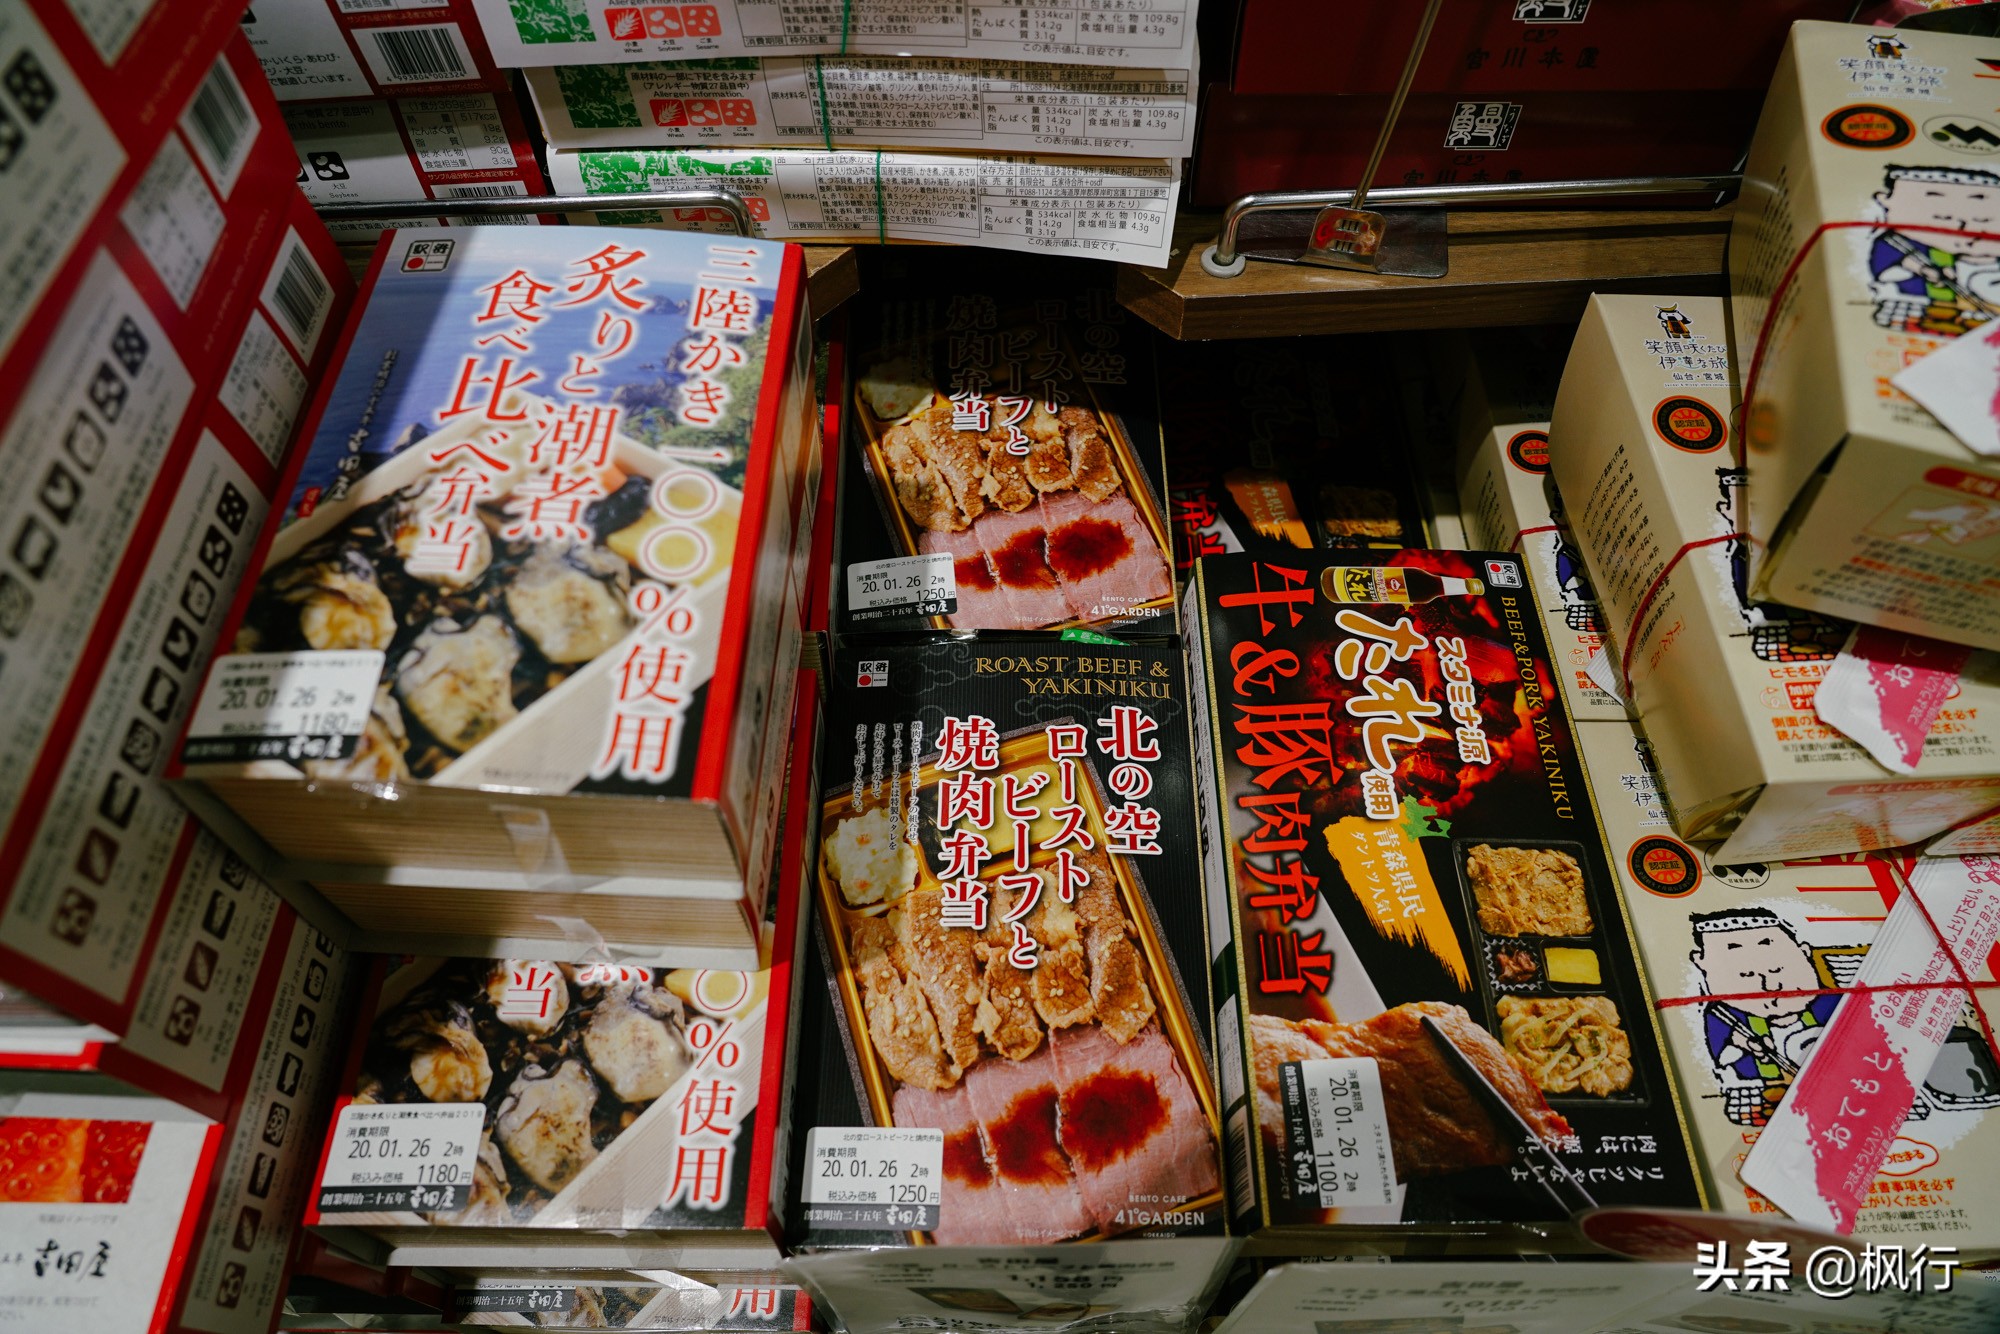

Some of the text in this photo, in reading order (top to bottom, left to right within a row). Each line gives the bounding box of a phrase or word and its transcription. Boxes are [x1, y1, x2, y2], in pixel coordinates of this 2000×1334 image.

[1034, 9, 1073, 20] 534kcal
[1145, 14, 1179, 25] 109.8g
[1034, 19, 1062, 31] 14.2g
[1081, 22, 1165, 36] 食塩相当量 4.3g
[1034, 30, 1055, 42] 3.1g
[771, 91, 807, 100] 原材料名
[461, 112, 497, 122] 517kcal
[1045, 106, 1081, 115] 534kcal
[1148, 110, 1179, 119] 109.8g
[1045, 116, 1071, 126] 14.2g
[1088, 118, 1166, 129] 食塩相当量 4.3g
[1045, 125, 1065, 135] 3.1g
[484, 135, 506, 145] 9.2g
[492, 157, 514, 167] 3.3g
[1019, 178, 1045, 186] 有限会社
[1038, 210, 1072, 219] 534kcal
[1133, 212, 1160, 224] 109.8g
[1038, 220, 1062, 228] 14.2g
[1078, 219, 1149, 233] 食塩相当量 4.3g
[1038, 228, 1057, 237] 3.1g
[947, 294, 999, 432] 焼肉弁当
[505, 244, 648, 541] 炙りと潮煮
[996, 330, 1038, 457] ビーフと
[411, 268, 556, 573] 食べ比べ弁当
[1674, 419, 1707, 428] 認定証
[856, 572, 888, 582] 消費期限
[906, 576, 921, 588] 26
[931, 576, 945, 585] 2時
[869, 597, 908, 606] 税込み価格
[916, 600, 948, 615] 吉田屋
[975, 656, 1171, 678] ROAST BEEF &
[1022, 677, 1172, 700] YAKINIKU
[1435, 636, 1492, 766] スタミナ源
[1335, 609, 1442, 821] たれ 使用
[1533, 716, 1574, 821] YAKINIKU
[1099, 706, 1164, 856] 北の空
[1041, 723, 1095, 903] ロースト
[935, 715, 1000, 930] 焼肉弁当
[1000, 773, 1047, 969] ビーフと
[1648, 860, 1681, 871] 認定証
[1373, 827, 1426, 919] 青森県民
[1347, 1068, 1364, 1112] 消費期限
[1821, 1050, 1894, 1151] おてもと
[1307, 1087, 1324, 1139] 税込み価格
[346, 1126, 391, 1138] 消費期限
[408, 1138, 432, 1158] 26
[443, 1141, 465, 1157] 2時
[817, 1147, 857, 1158] 消費期限
[1338, 1137, 1359, 1158] 26
[1842, 1125, 1883, 1193] つまようじ入り
[878, 1160, 898, 1178] 26
[910, 1163, 929, 1178] 2時
[1293, 1149, 1318, 1196] 吉田屋
[351, 1172, 405, 1183] 税込み価格
[1343, 1171, 1359, 1193] 2時
[321, 1186, 456, 1210] 創業明治二十五年 吉田屋
[828, 1190, 877, 1201] 税込み価格
[1129, 1194, 1187, 1203] BENTO CAFE
[803, 1205, 928, 1228] 創業明治二十五年 吉田屋
[456, 1291, 563, 1310] 創業明治二十五年 吉田屋
